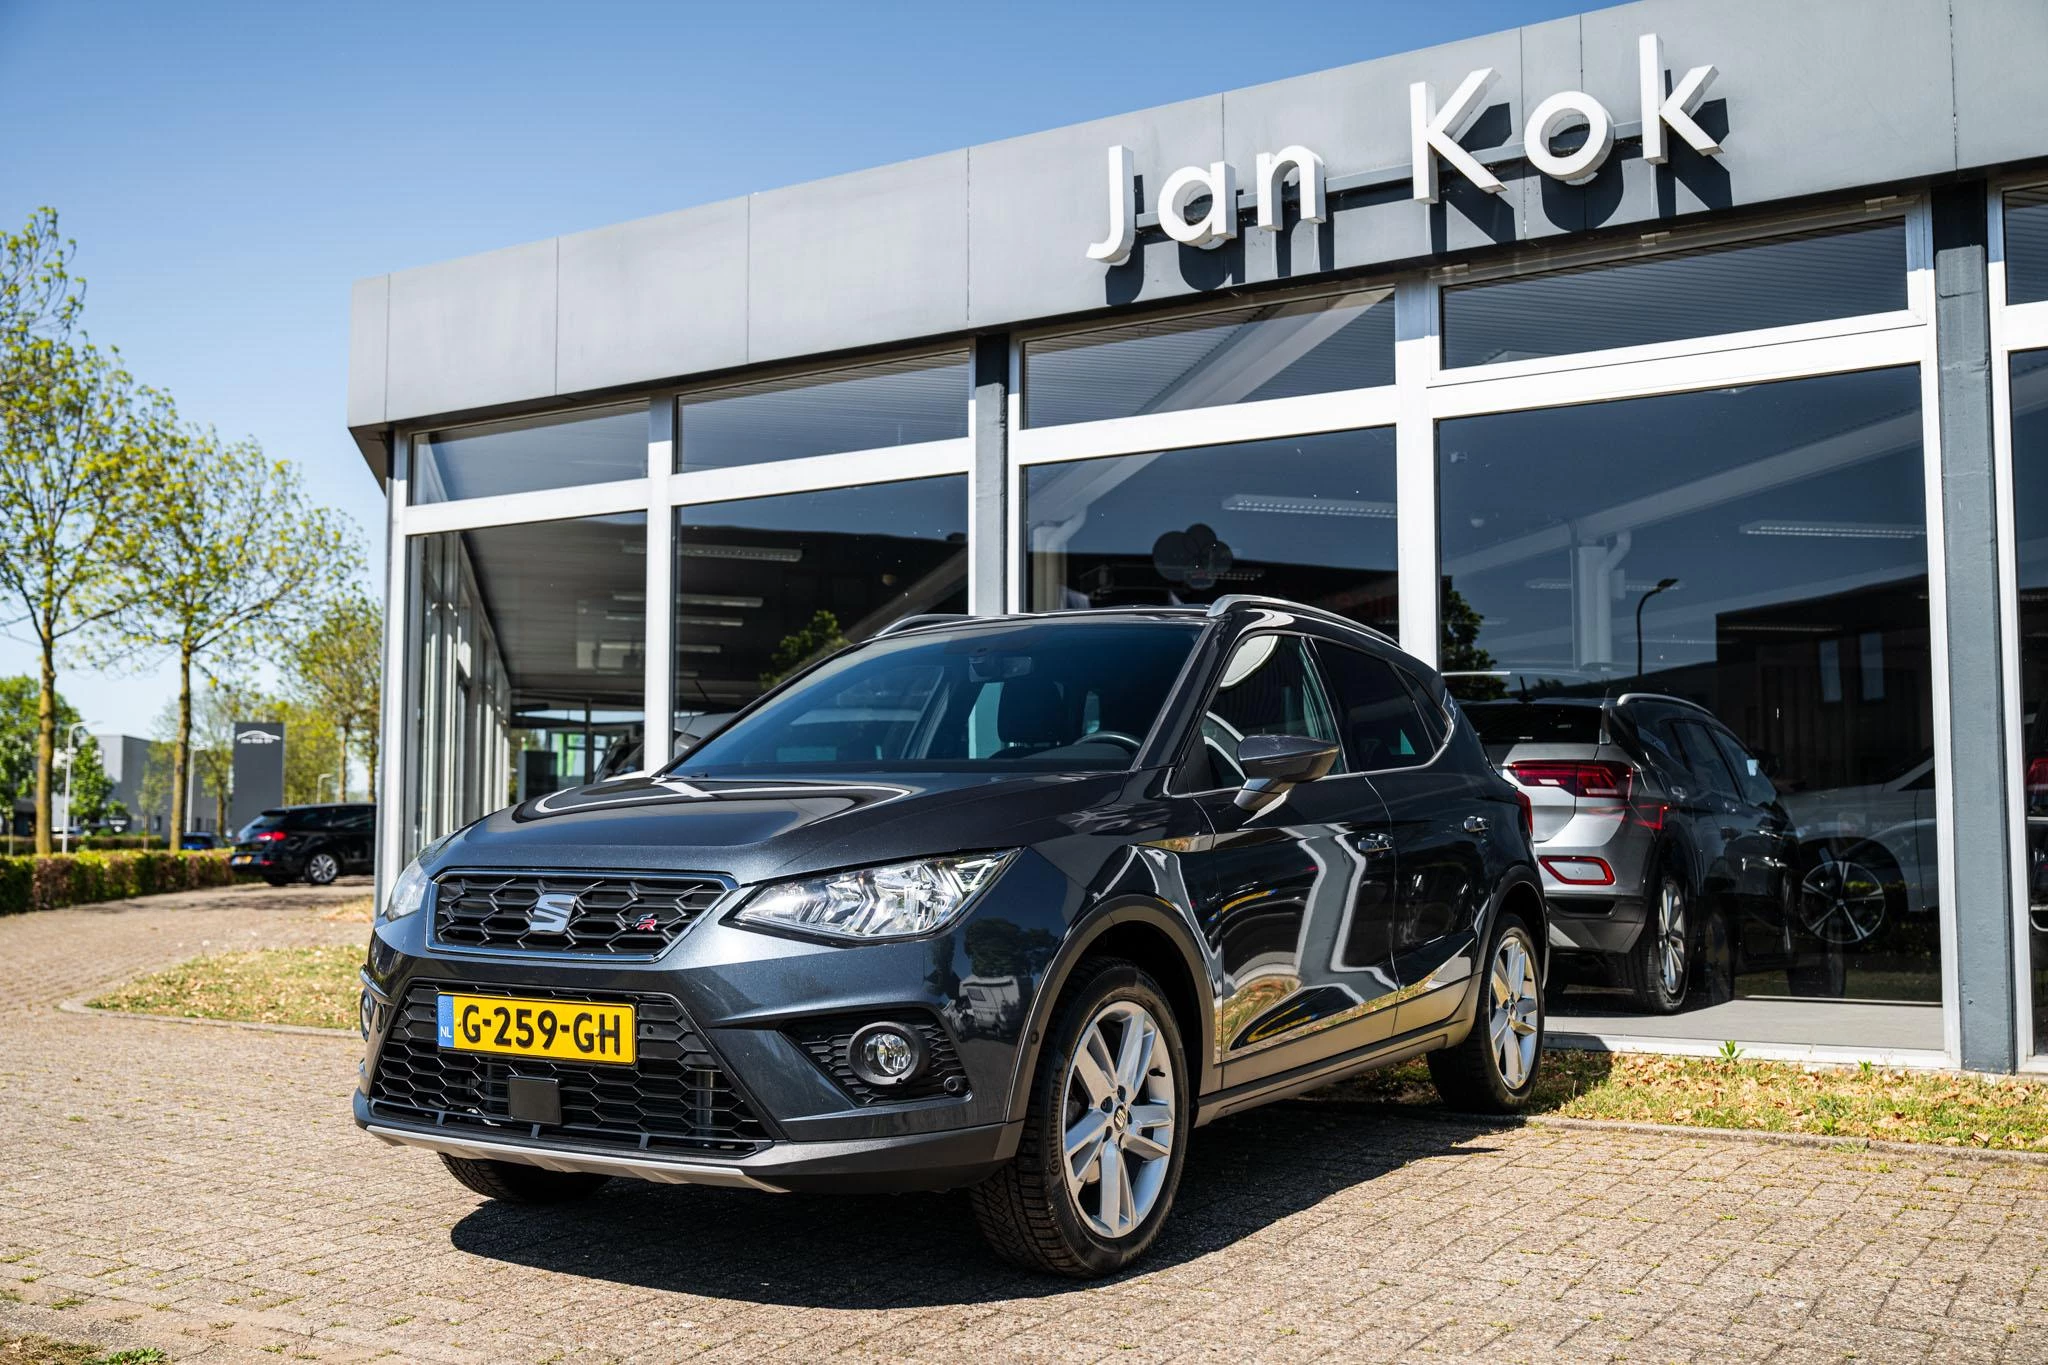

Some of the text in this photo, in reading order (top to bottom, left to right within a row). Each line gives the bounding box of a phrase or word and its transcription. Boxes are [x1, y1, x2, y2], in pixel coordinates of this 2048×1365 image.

[1086, 33, 1724, 267] Jan Kok
[440, 1025, 453, 1038] NL
[462, 1005, 620, 1055] G-259-GH
